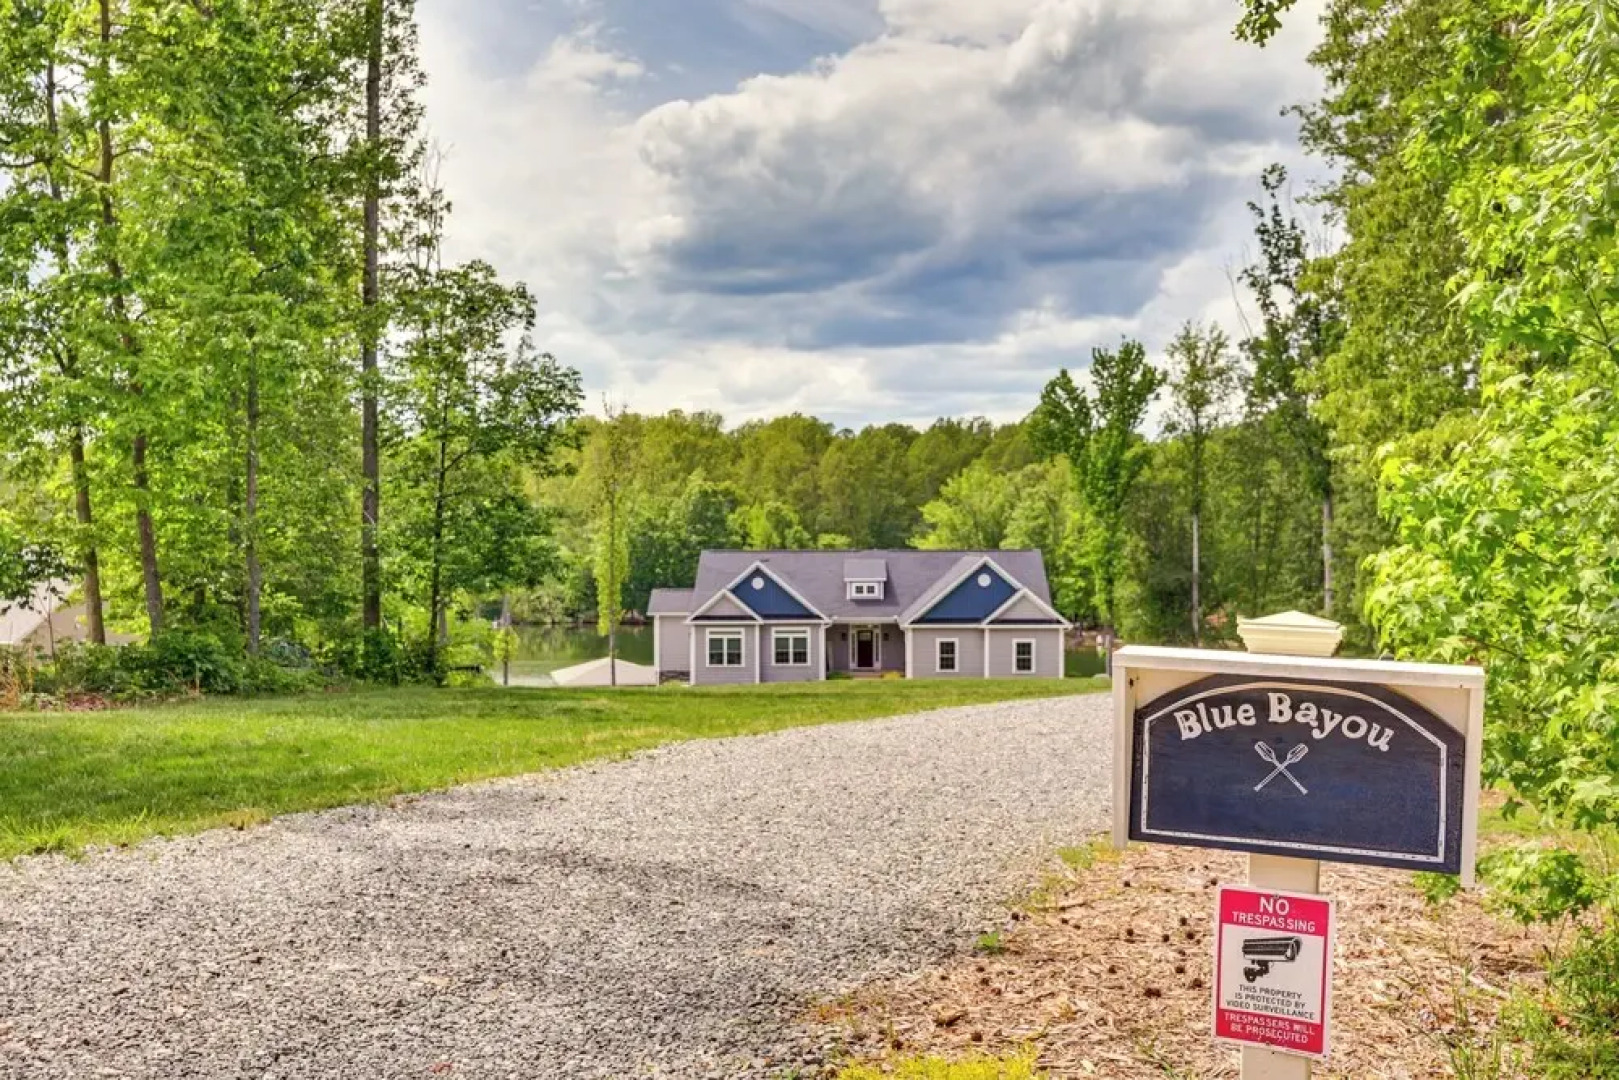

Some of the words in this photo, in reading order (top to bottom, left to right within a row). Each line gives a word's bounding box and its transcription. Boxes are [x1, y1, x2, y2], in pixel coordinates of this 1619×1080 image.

[1174, 702, 1257, 741] Blue
[1267, 692, 1395, 752] Bayou
[1260, 897, 1290, 915] NO
[1232, 911, 1316, 932] TRESPASSING
[1235, 992, 1242, 1000] IS
[1245, 993, 1292, 1007] PROTECTED
[1294, 1001, 1305, 1009] BY
[1239, 984, 1257, 993] THIS
[1260, 987, 1302, 999] PROPERTY
[1226, 1000, 1249, 1010] VIDEO
[1253, 1004, 1314, 1020] SURVEILLANCE
[1224, 1012, 1290, 1031] TRESPASSERS
[1293, 1024, 1315, 1035] WILL
[1230, 1022, 1242, 1032] BE
[1246, 1024, 1308, 1043] PROSECUTED
